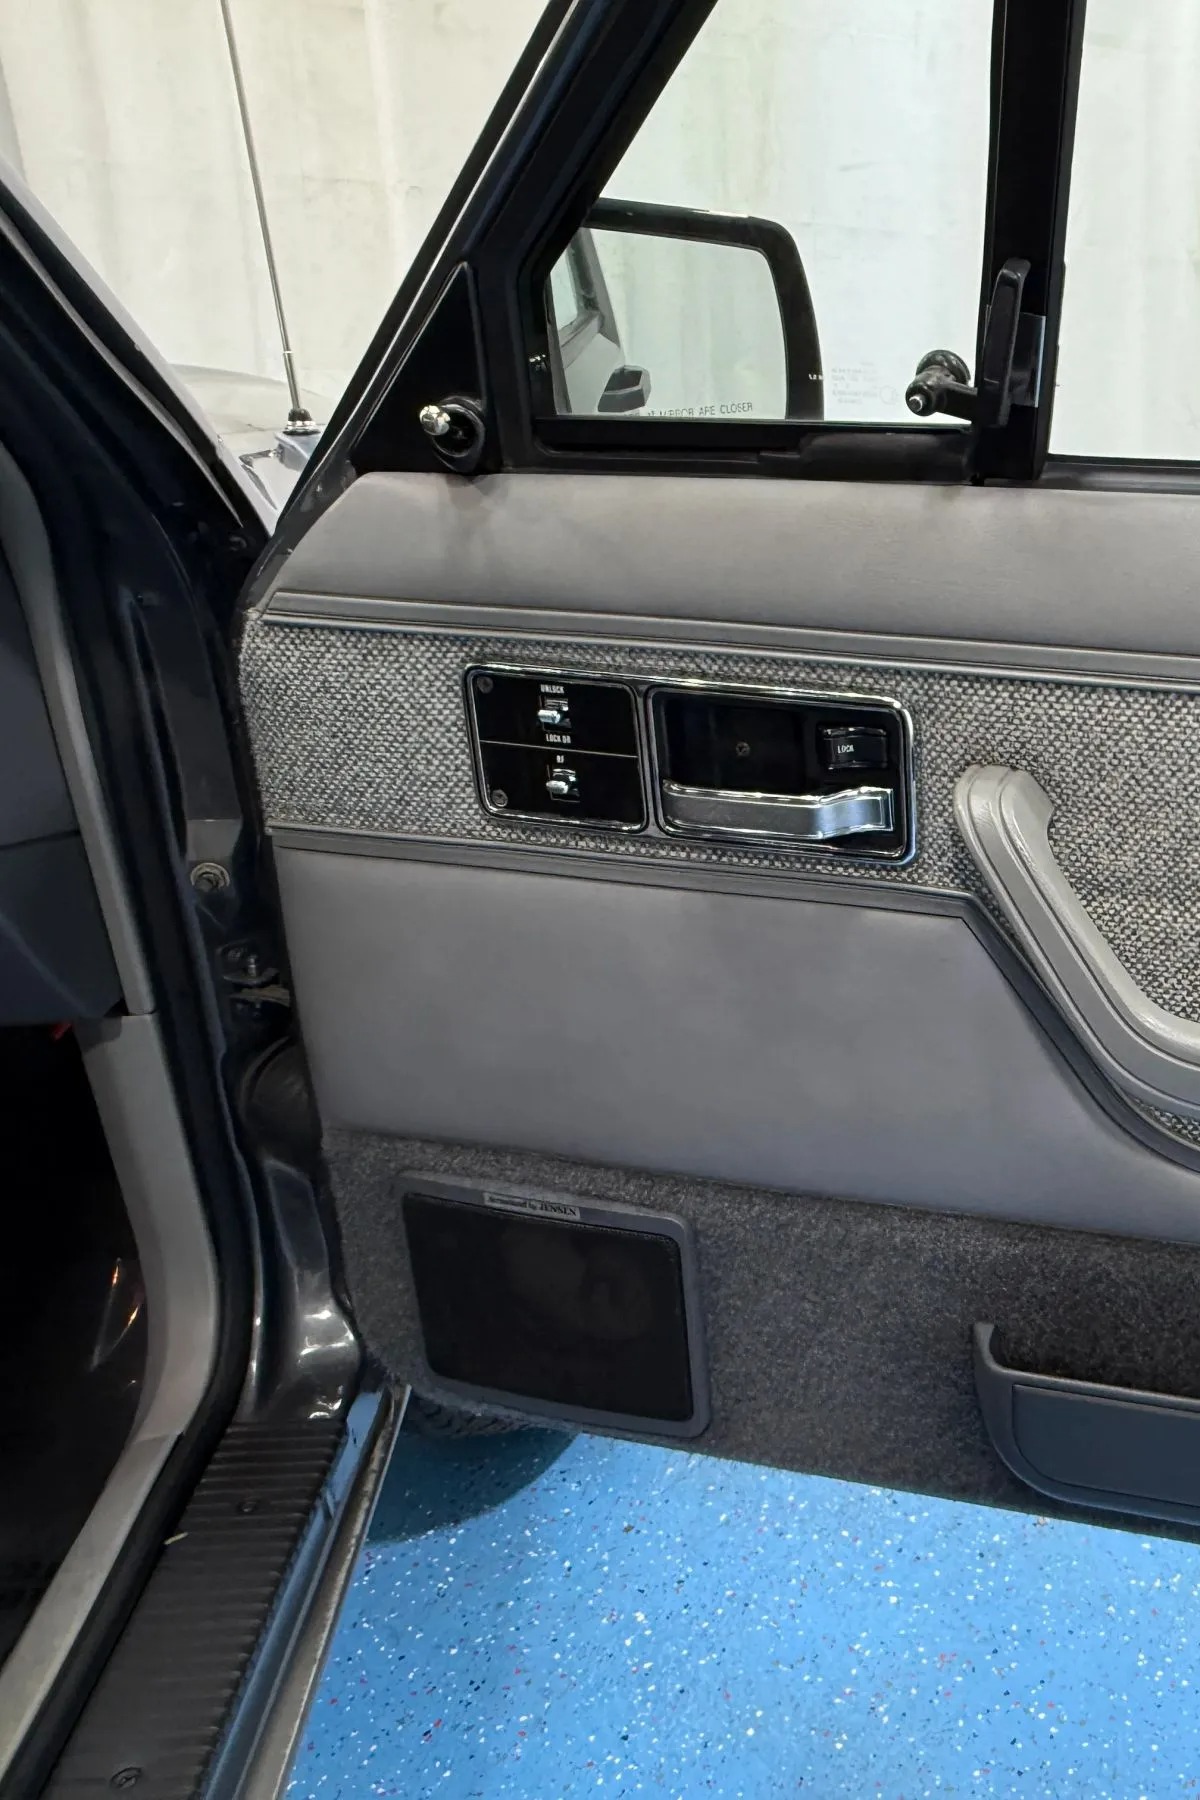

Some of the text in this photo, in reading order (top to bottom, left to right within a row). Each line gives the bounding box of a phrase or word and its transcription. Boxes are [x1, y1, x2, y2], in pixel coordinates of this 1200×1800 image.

[719, 402, 753, 414] CLOSER
[540, 684, 565, 694] UNLOCK
[545, 733, 562, 743] LOCK
[837, 744, 855, 754] LOCK
[539, 1202, 577, 1216] JENSEN
